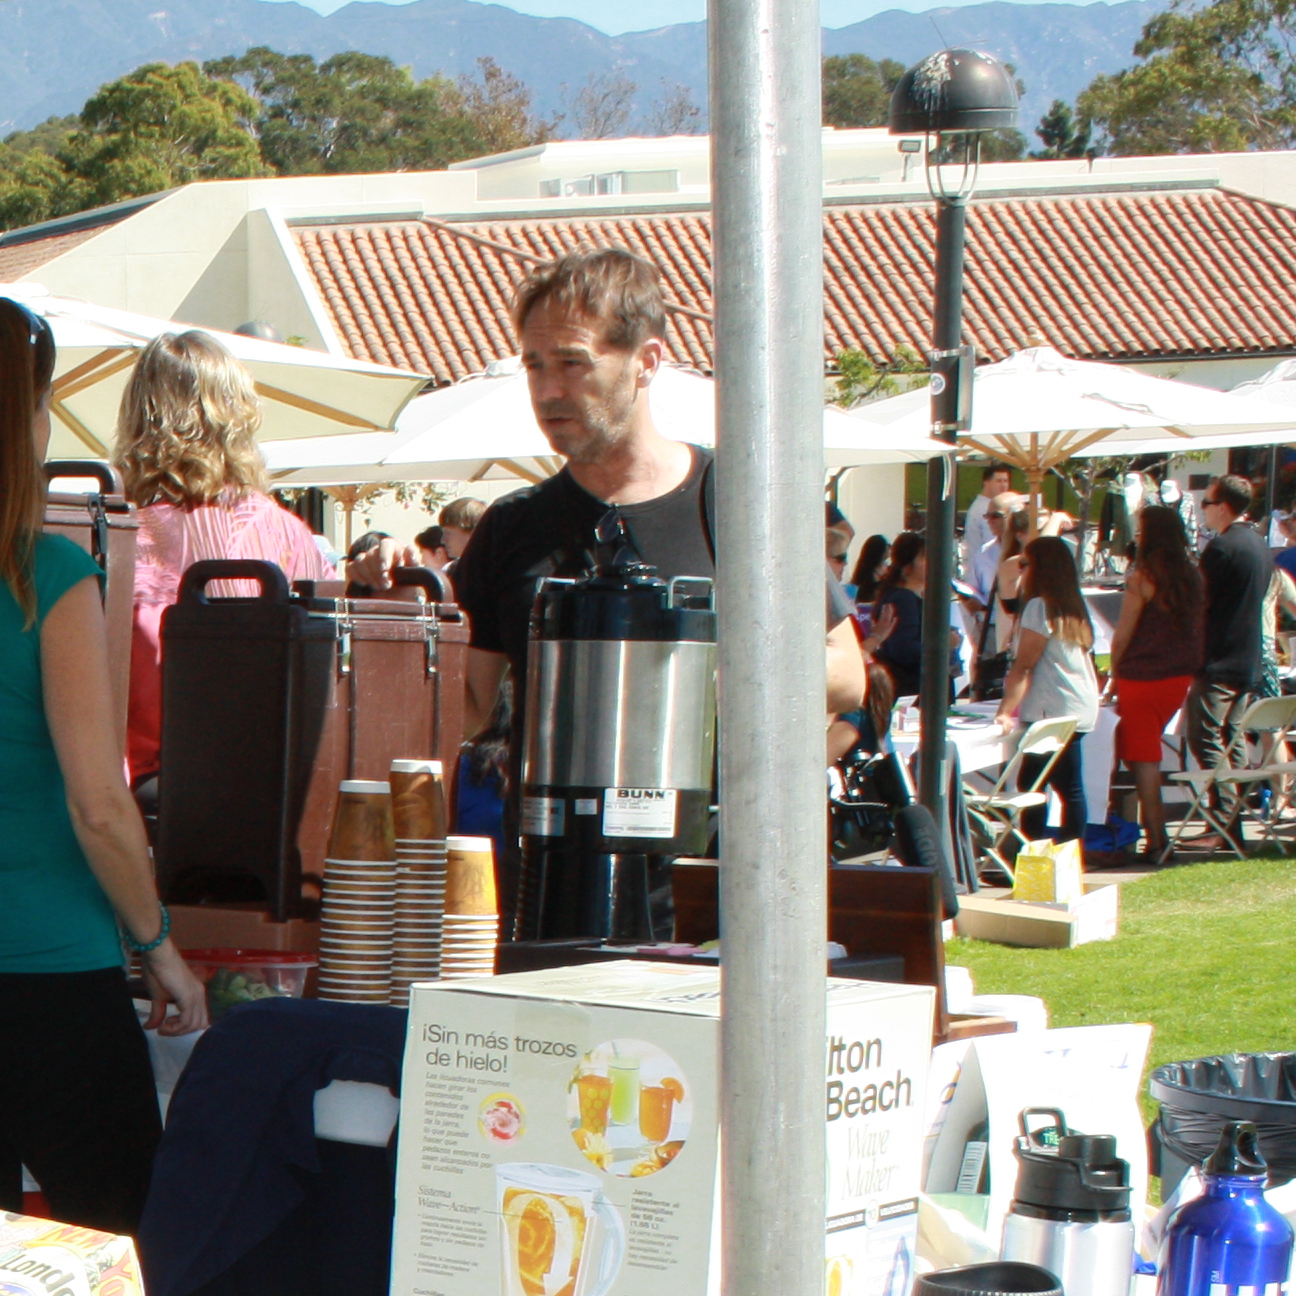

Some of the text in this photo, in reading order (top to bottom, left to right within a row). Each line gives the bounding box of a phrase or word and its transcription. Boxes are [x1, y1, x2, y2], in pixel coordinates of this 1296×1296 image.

[616, 789, 666, 800] BUNN
[422, 1022, 577, 1058] ¡Sin más trozos
[826, 1034, 884, 1076] lton
[425, 1047, 508, 1074] de hielo!
[825, 1069, 913, 1122] Beach
[847, 1123, 890, 1161] Wave
[418, 1184, 452, 1199] Sistema
[841, 1156, 894, 1201] Maker
